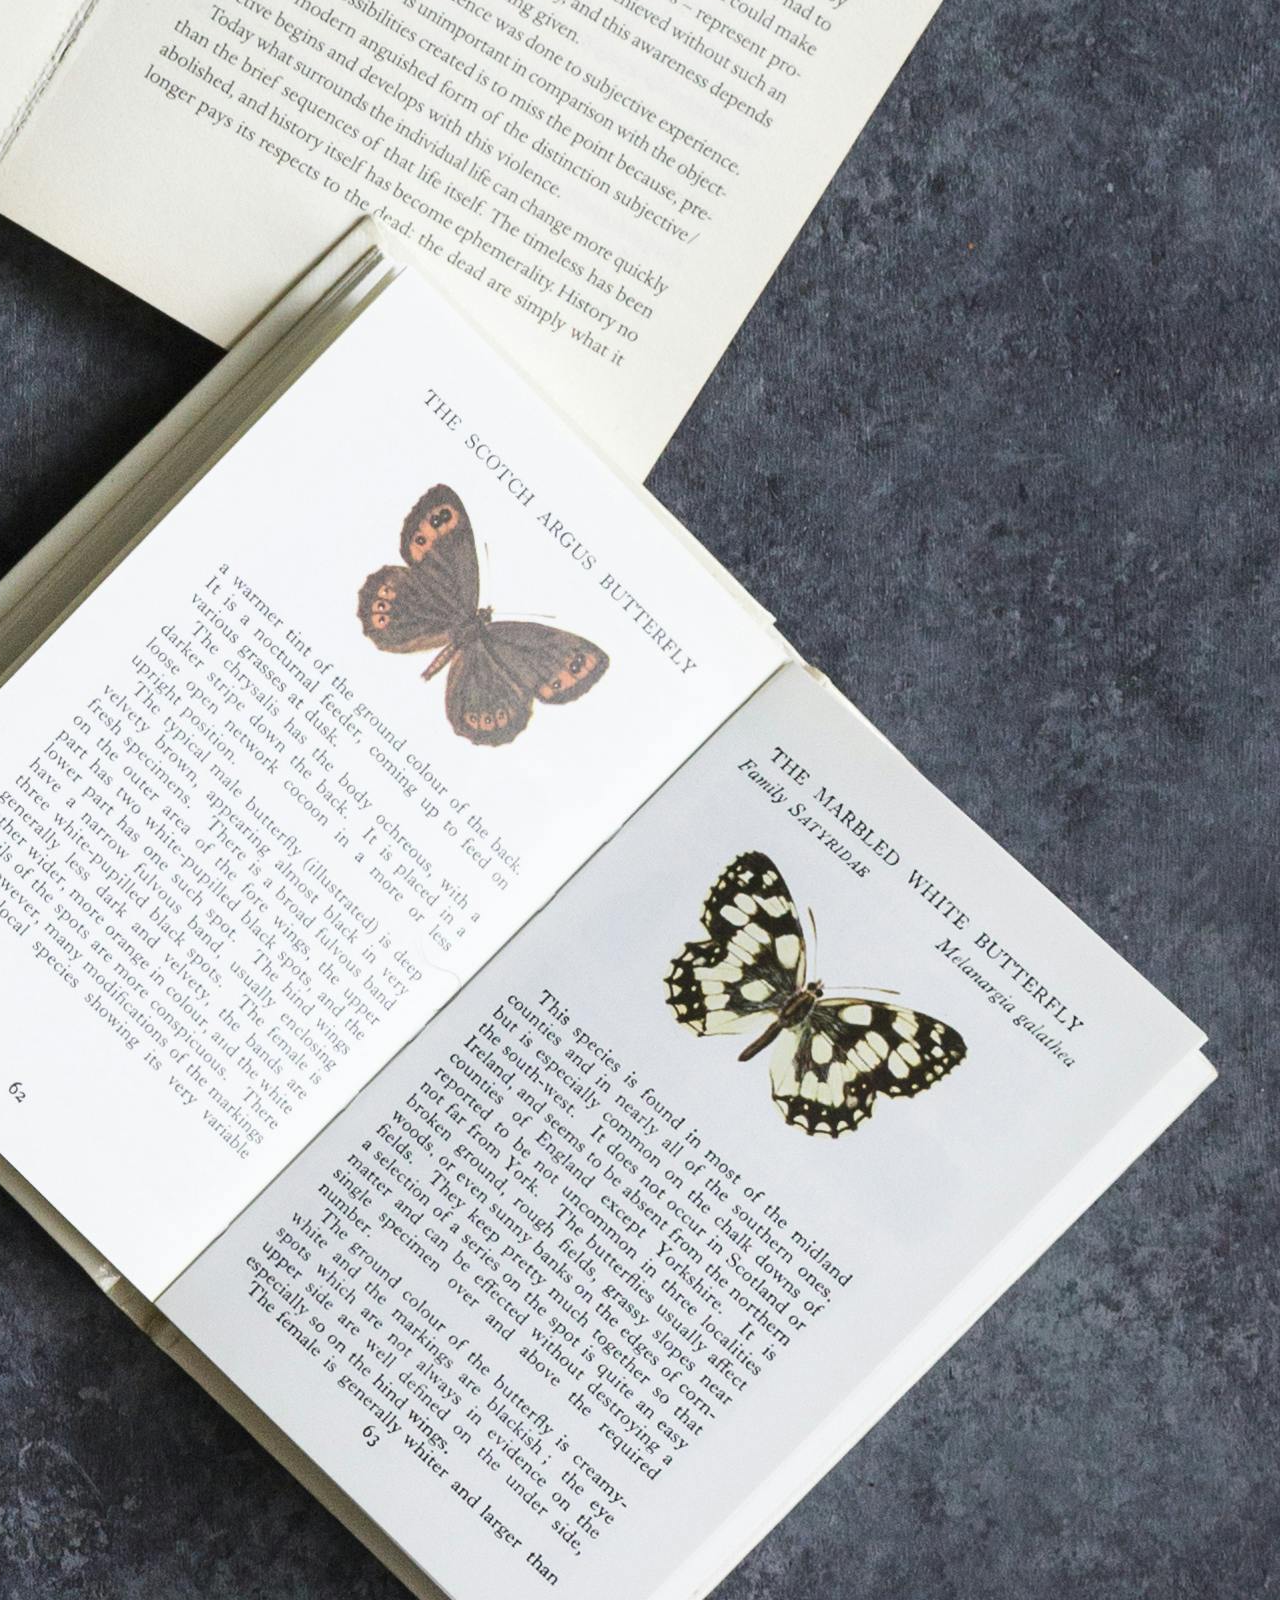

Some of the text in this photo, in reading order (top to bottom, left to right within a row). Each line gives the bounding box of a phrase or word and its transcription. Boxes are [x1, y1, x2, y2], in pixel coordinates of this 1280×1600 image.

[531, 9, 579, 45] given.
[423, 388, 697, 674] THE SCOTCH ARGUS BUTTERFLY
[103, 683, 409, 997] velvety brown, appearing almost black in very
[191, 619, 481, 923] The chrysalis has the body ochreous, with a
[736, 757, 788, 804] Family
[770, 745, 1085, 1033] THE MARBLED WHITE BUTTERFLY
[7, 1081, 27, 1104] 62
[31, 940, 80, 989] species
[83, 992, 140, 1051] showing
[142, 1048, 163, 1071] its
[168, 1074, 198, 1106] very
[202, 1108, 250, 1160] variable
[933, 937, 1076, 1068] Melanargia galathea
[317, 1182, 372, 1238] number.
[405, 1091, 733, 1405] broken ground, rough fields, grassy slopes near
[448, 1052, 777, 1362] counties of England except Yorkshire. It is
[247, 1279, 559, 1586] The female is generally whiter and larger than
[361, 1424, 381, 1448] 63
